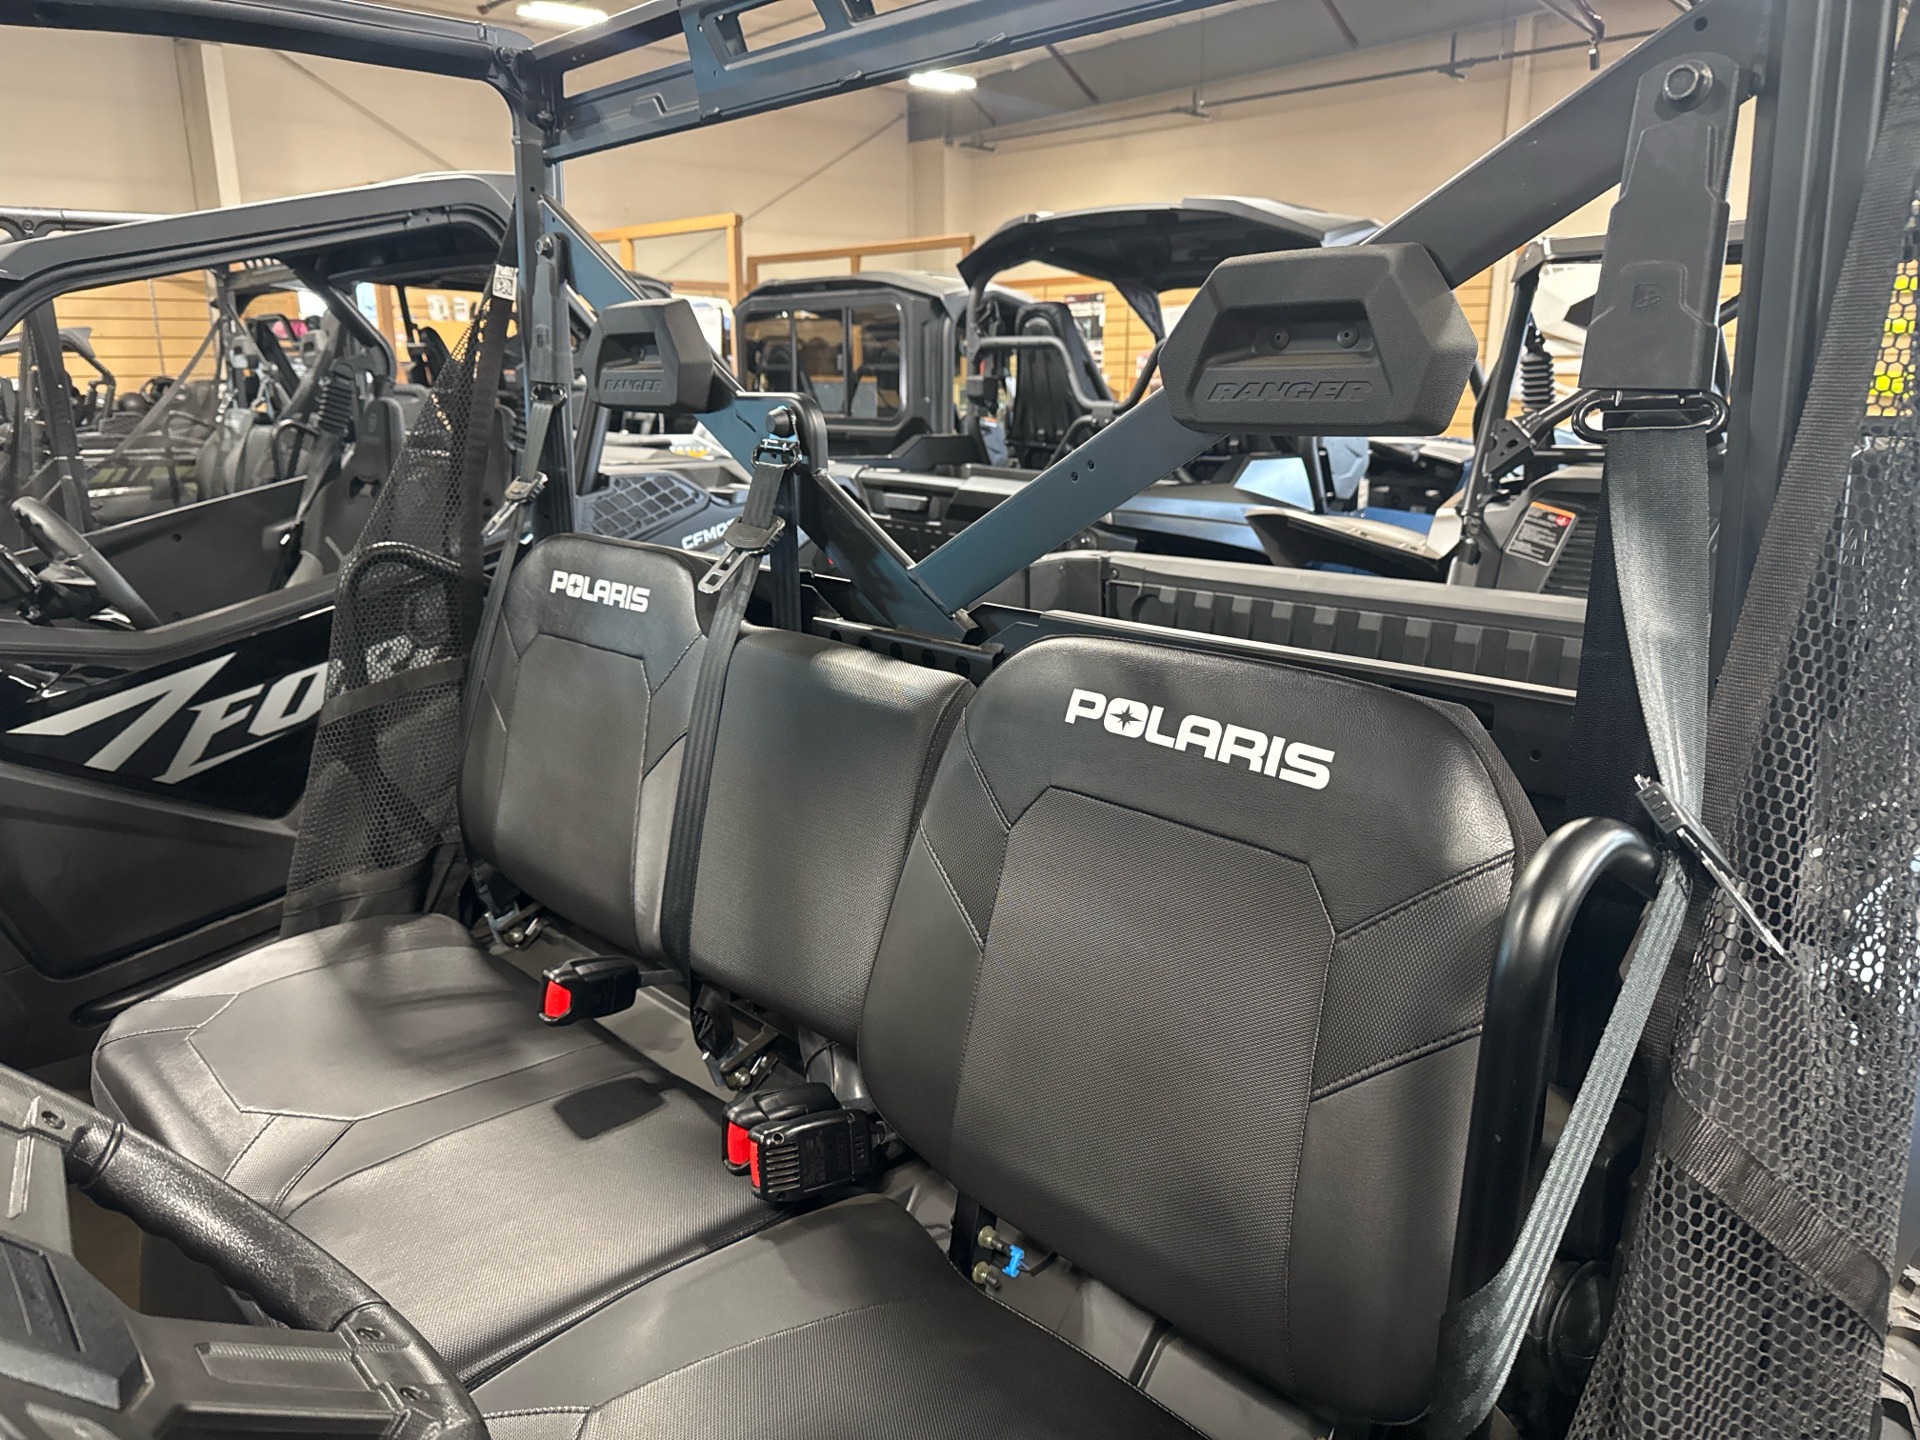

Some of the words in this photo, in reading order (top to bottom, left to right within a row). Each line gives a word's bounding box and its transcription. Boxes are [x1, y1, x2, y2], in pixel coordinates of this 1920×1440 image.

[603, 378, 664, 393] RANGER
[1207, 380, 1374, 401] RANGER
[681, 517, 736, 550] CFMO
[549, 569, 651, 613] POLARIS
[1064, 688, 1336, 790] POLARIS
